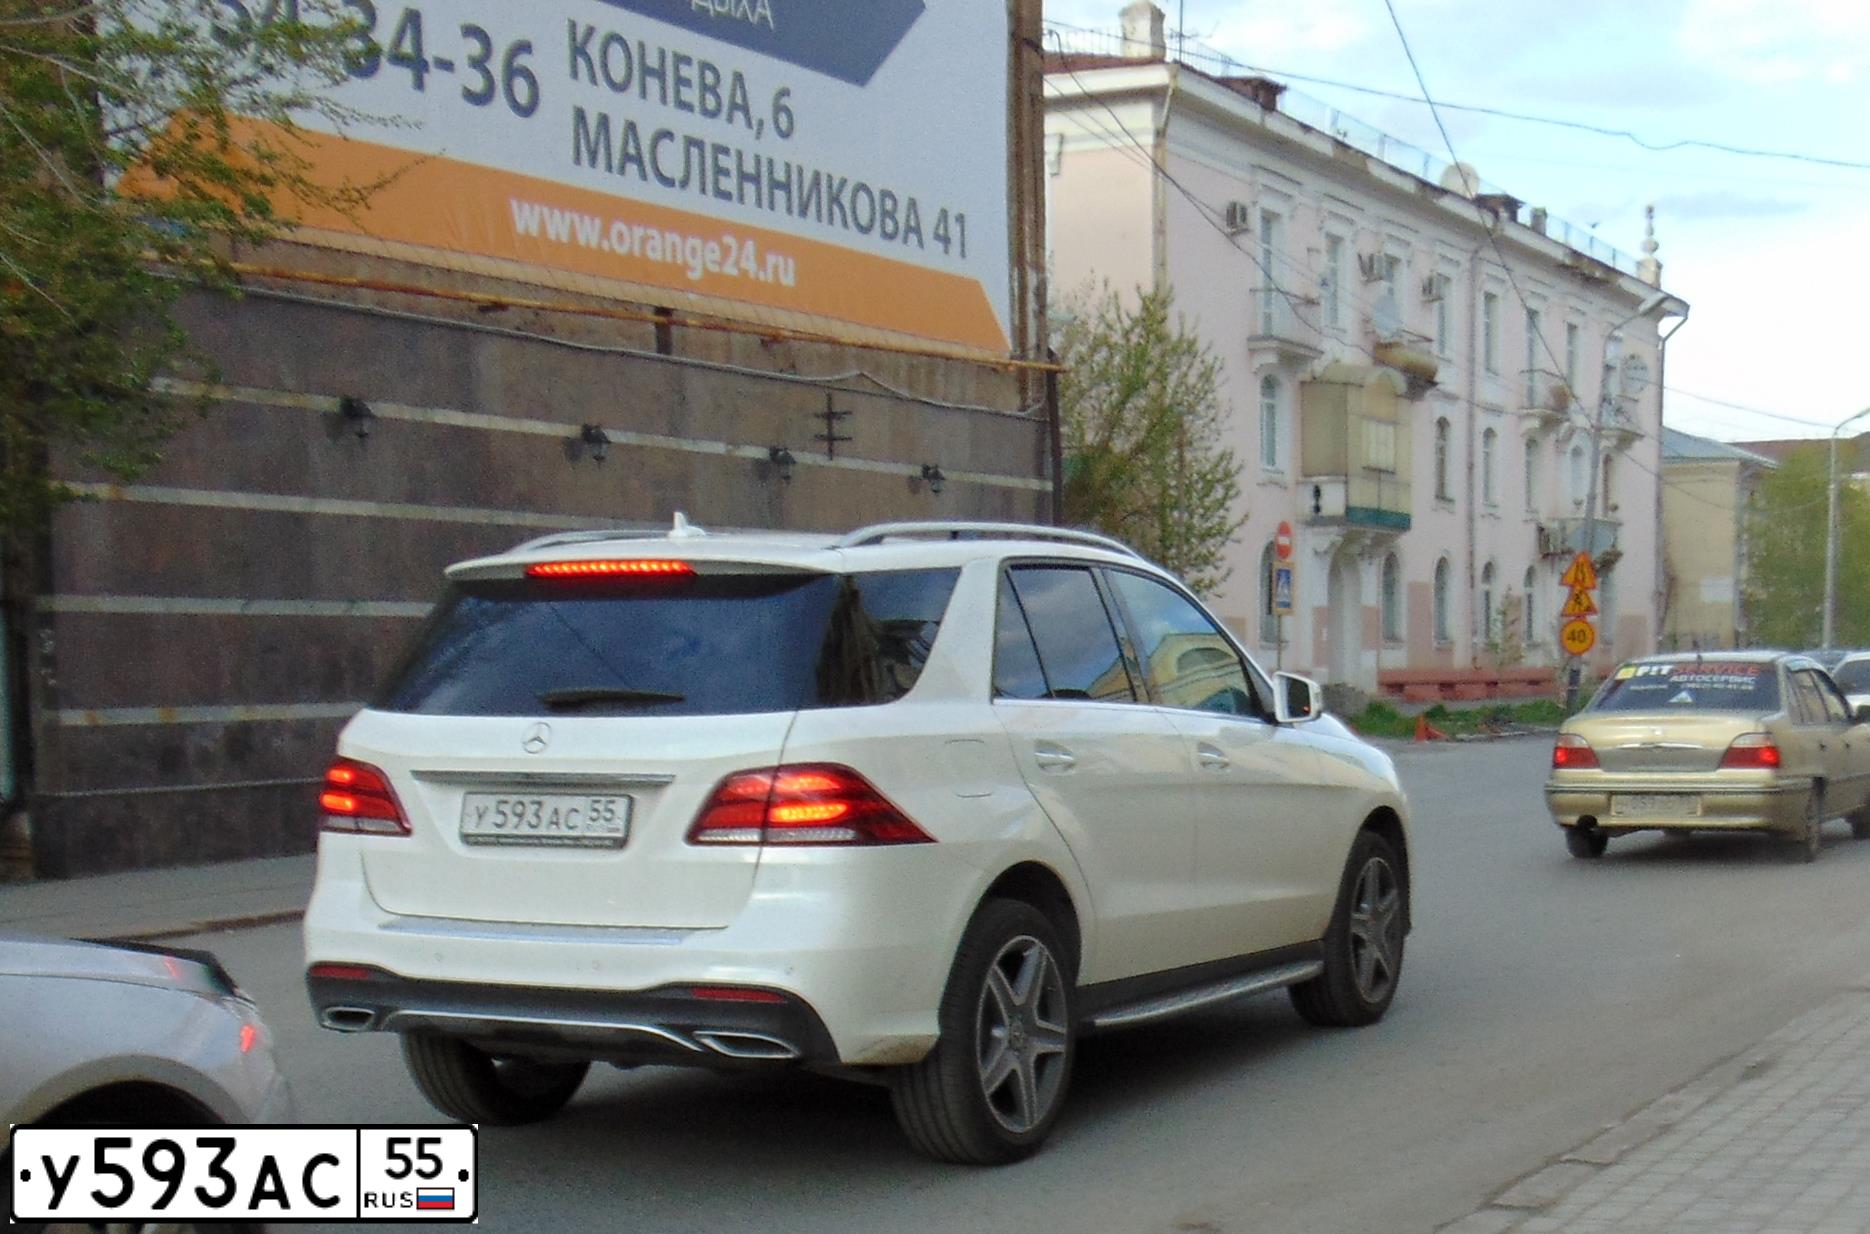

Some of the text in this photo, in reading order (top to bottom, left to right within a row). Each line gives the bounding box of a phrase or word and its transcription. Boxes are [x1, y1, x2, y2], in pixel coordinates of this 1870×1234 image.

[771, 86, 795, 140] 6
[571, 105, 967, 259] МАСЛЕННИКОВА 41
[511, 198, 796, 288] www.orange24.ru
[1567, 628, 1586, 643] 40
[1636, 665, 1674, 677] FIT
[588, 799, 616, 822] 55
